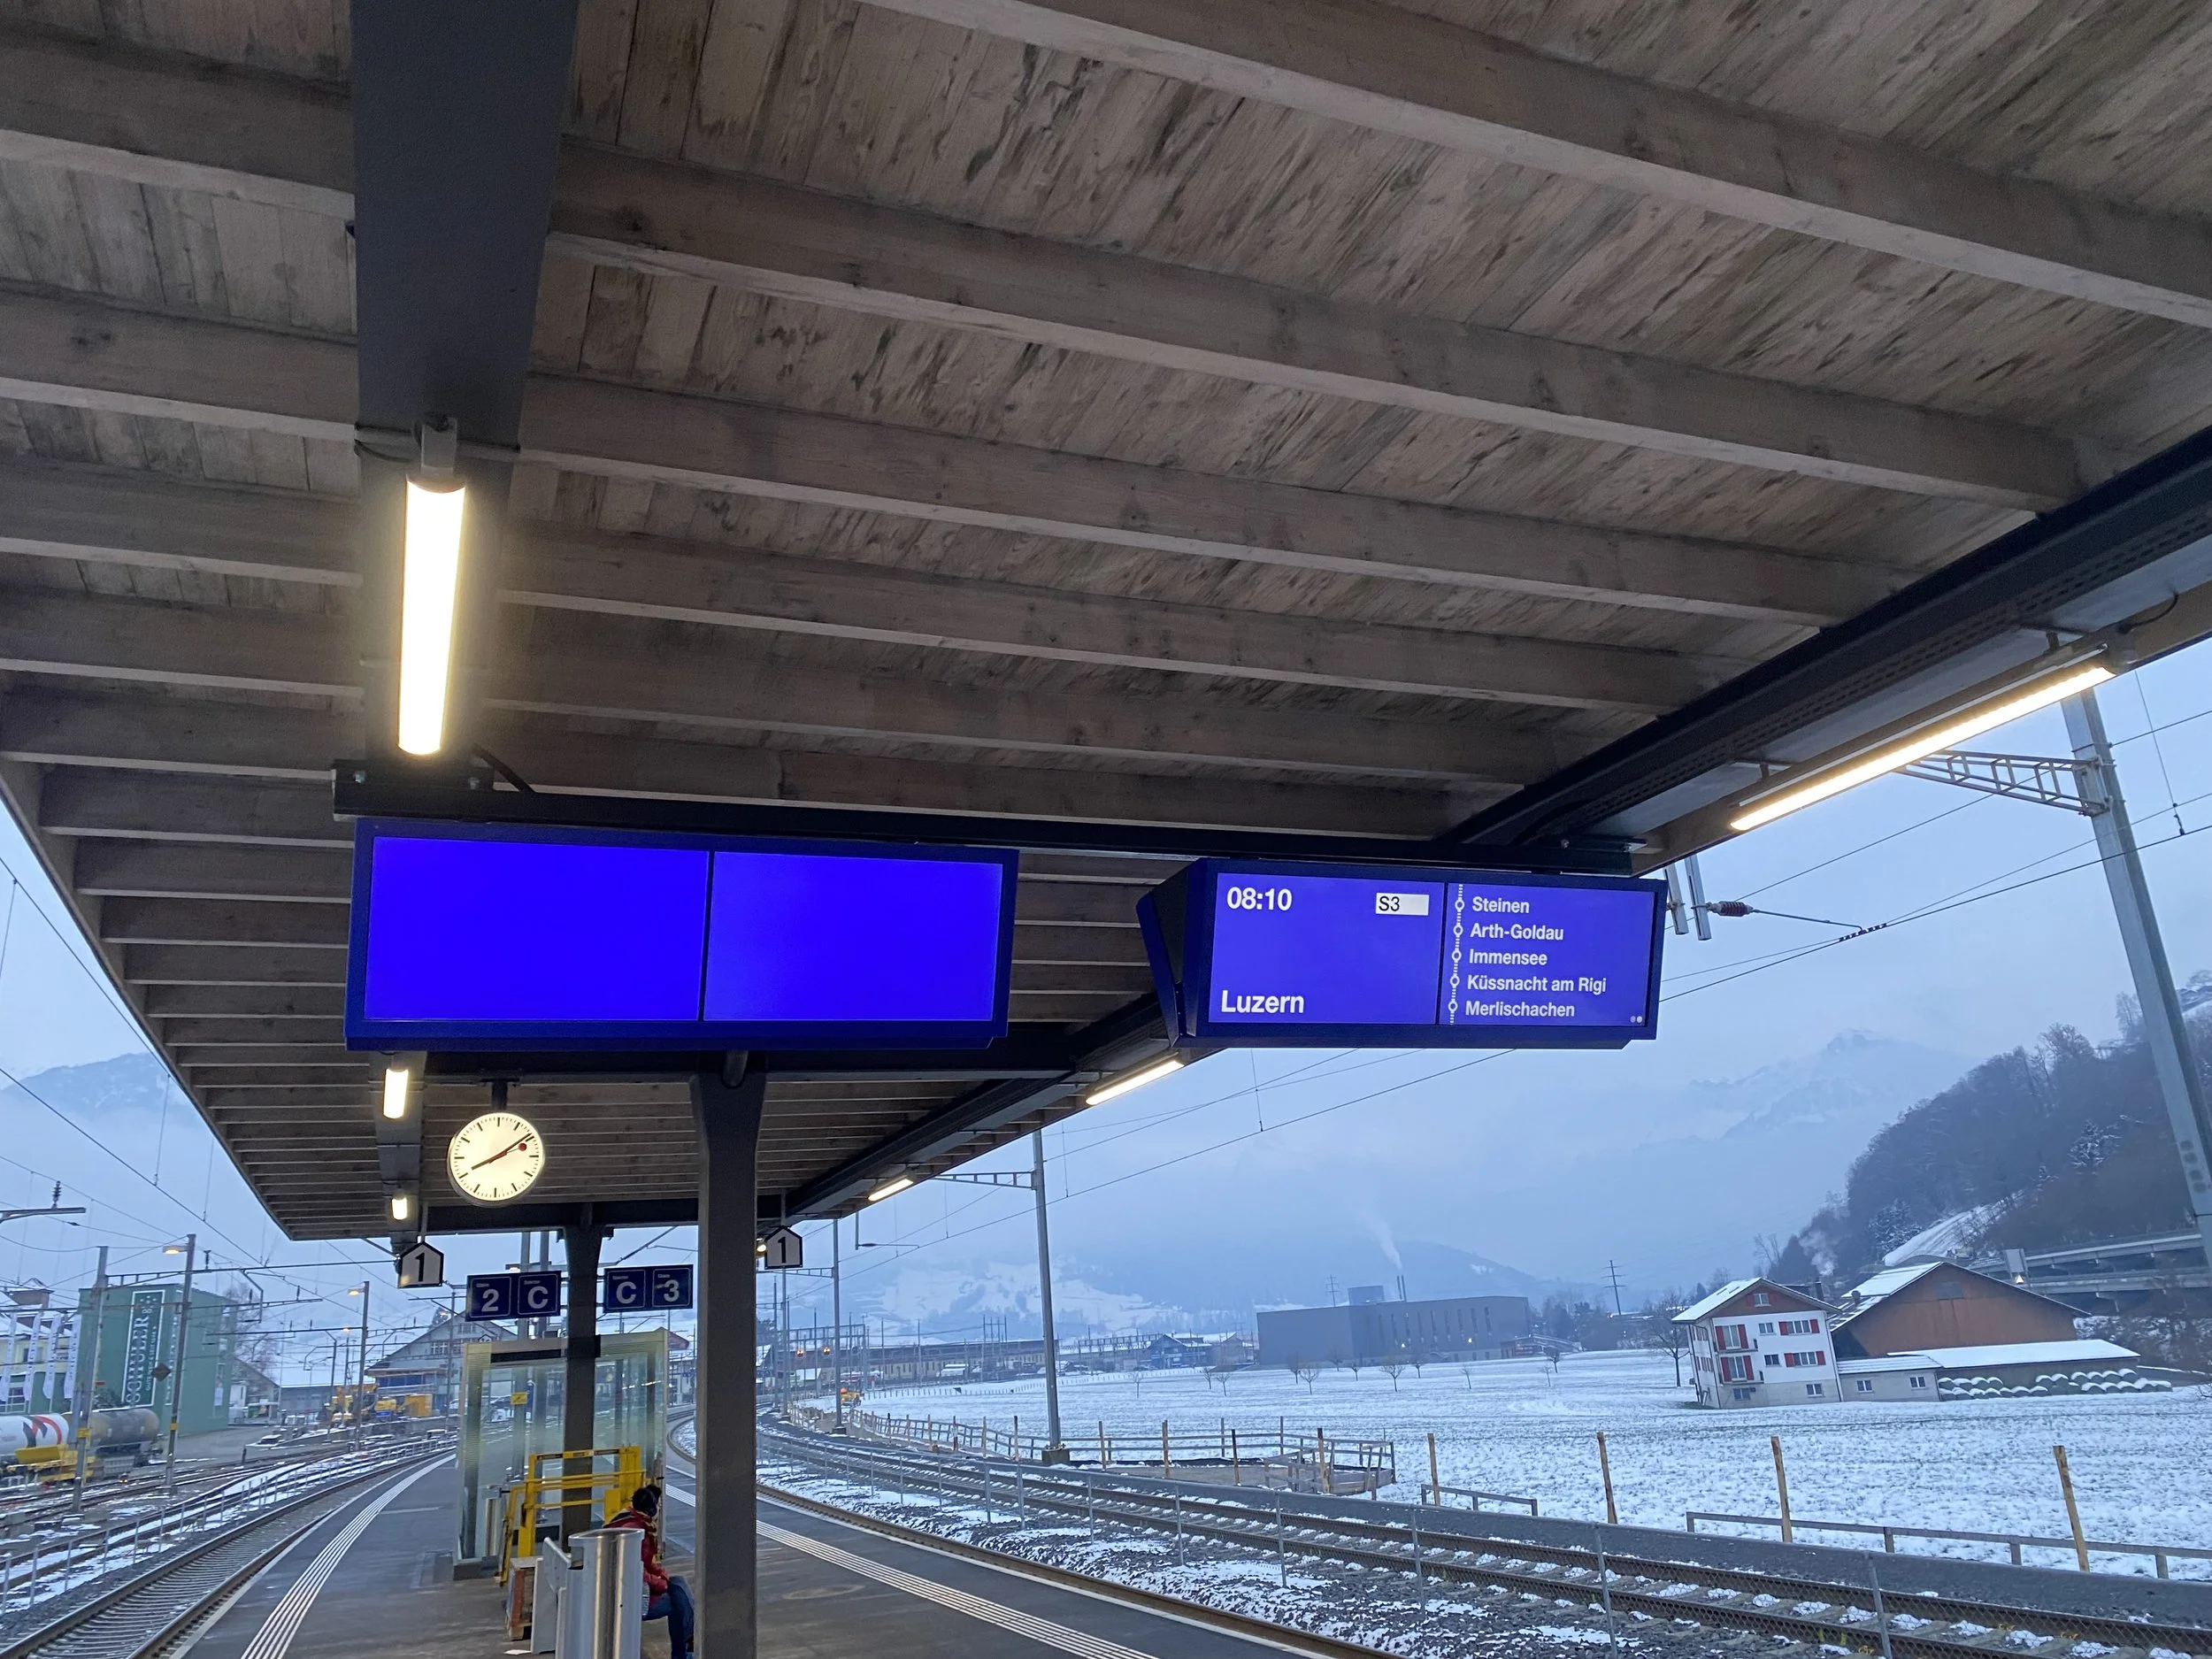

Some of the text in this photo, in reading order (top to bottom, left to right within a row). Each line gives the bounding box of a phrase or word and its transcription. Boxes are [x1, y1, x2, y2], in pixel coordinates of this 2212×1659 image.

[1226, 887, 1293, 911] 08:10
[1378, 895, 1401, 912] S3
[1471, 896, 1530, 914] Steinen
[1470, 923, 1564, 941] Arth-Goldau
[1469, 949, 1548, 966] Immensee
[1467, 974, 1607, 996] Küssnacht am Rigi
[1220, 989, 1305, 1014] Luzern
[1465, 1001, 1575, 1018] Merlischachen
[778, 1236, 786, 1263] 1
[415, 1252, 425, 1282] 1
[480, 1288, 500, 1312] 2
[527, 1286, 549, 1310] C
[616, 1281, 637, 1304] C
[664, 1279, 680, 1302] 3
[126, 1316, 150, 1403] SCHULER
